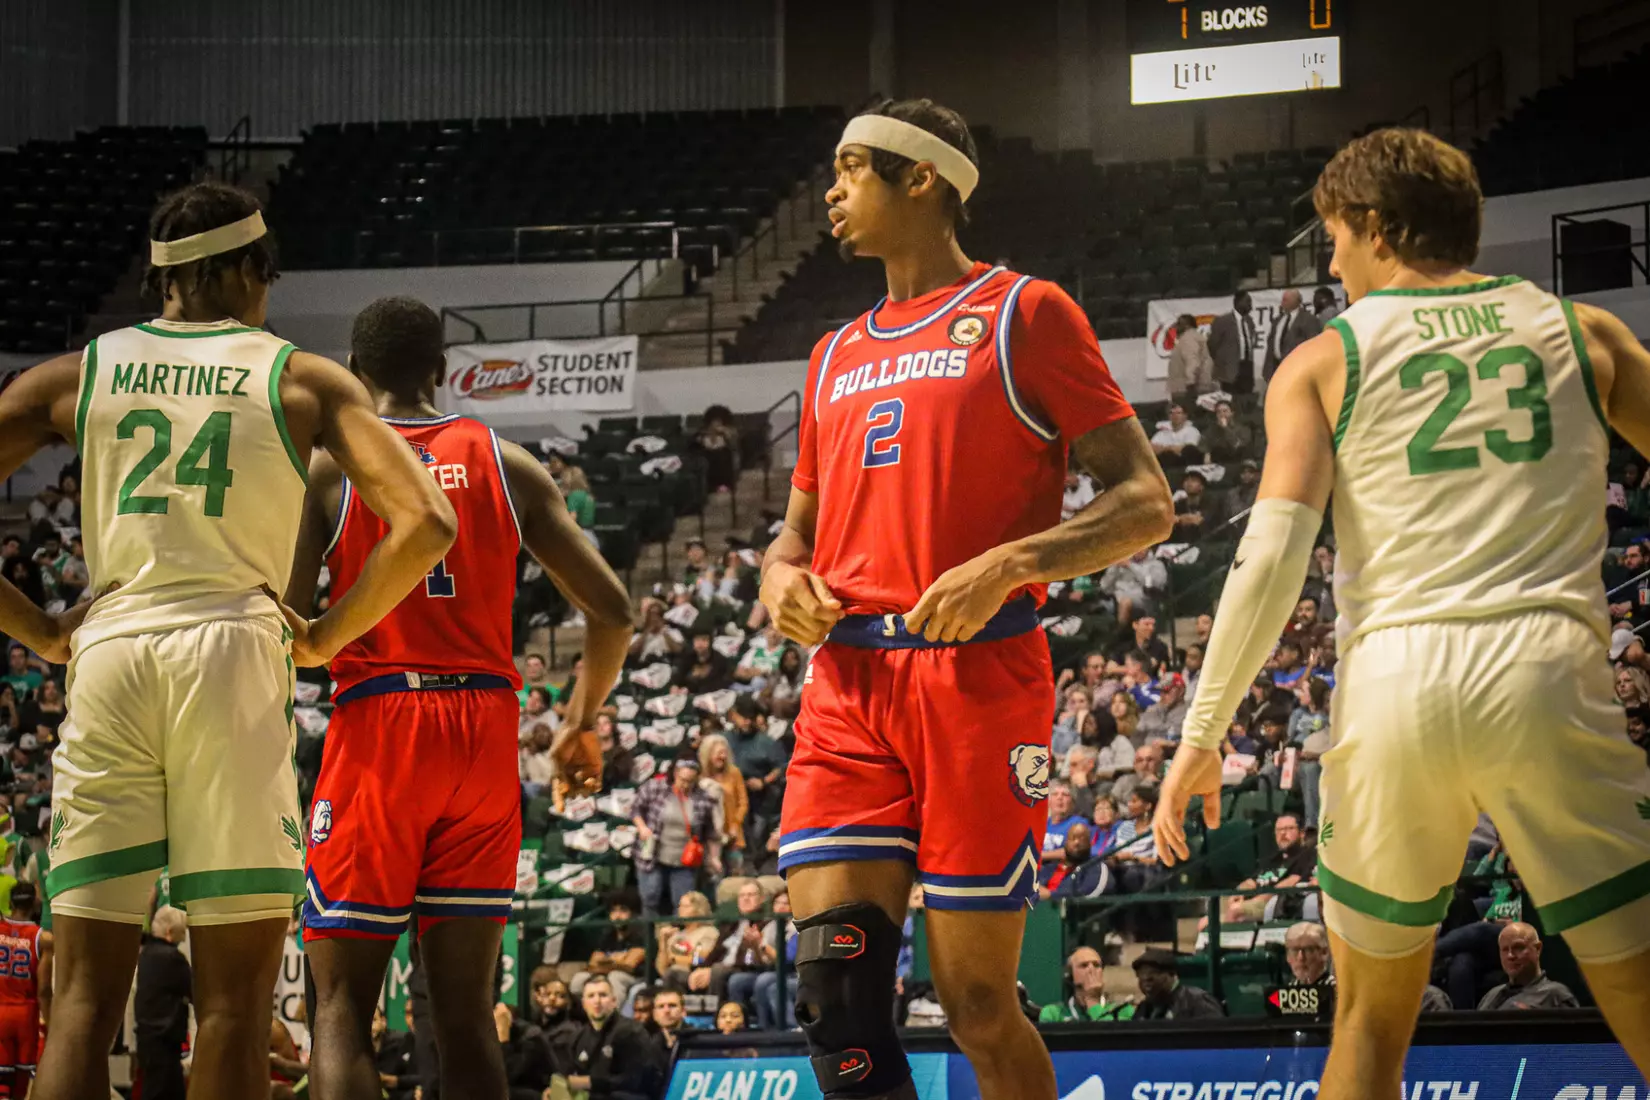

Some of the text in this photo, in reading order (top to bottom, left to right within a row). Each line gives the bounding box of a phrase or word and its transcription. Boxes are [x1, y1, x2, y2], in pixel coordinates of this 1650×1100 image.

[1201, 6, 1268, 31] BLOCKS
[1412, 302, 1514, 340] STONE
[537, 350, 633, 373] STUDENT
[829, 348, 970, 404] BULLDOGS
[111, 362, 251, 396] MARTINEZ
[536, 374, 624, 396] SECTION
[1399, 344, 1553, 476] 23
[861, 397, 905, 469] 2
[116, 408, 234, 517] 24
[1279, 988, 1319, 1009] POSS
[681, 1069, 798, 1100] PLAN TO
